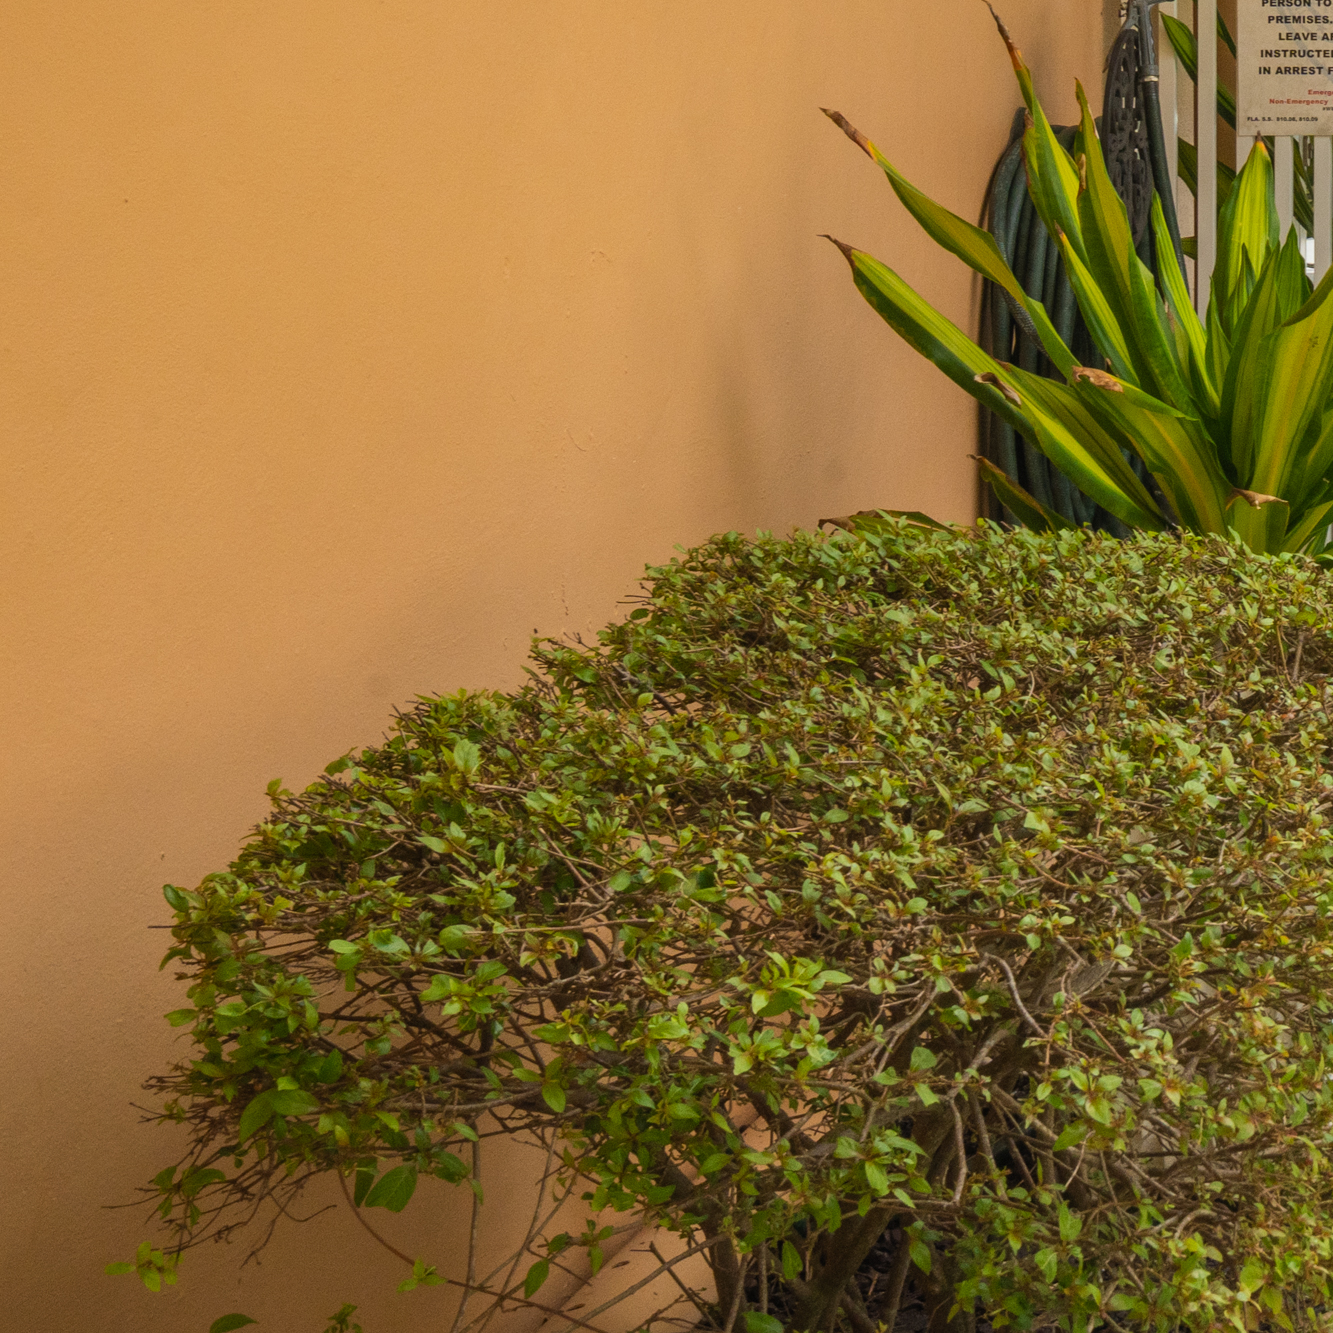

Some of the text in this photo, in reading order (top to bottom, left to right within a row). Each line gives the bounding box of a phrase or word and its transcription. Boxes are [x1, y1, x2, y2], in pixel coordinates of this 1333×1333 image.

[1267, 15, 1333, 25] PREMISES.
[1278, 32, 1318, 42] LEAVE
[1258, 66, 1271, 76] IN
[1275, 66, 1324, 76] ARREST
[1268, 98, 1329, 106] Non-Emergency
